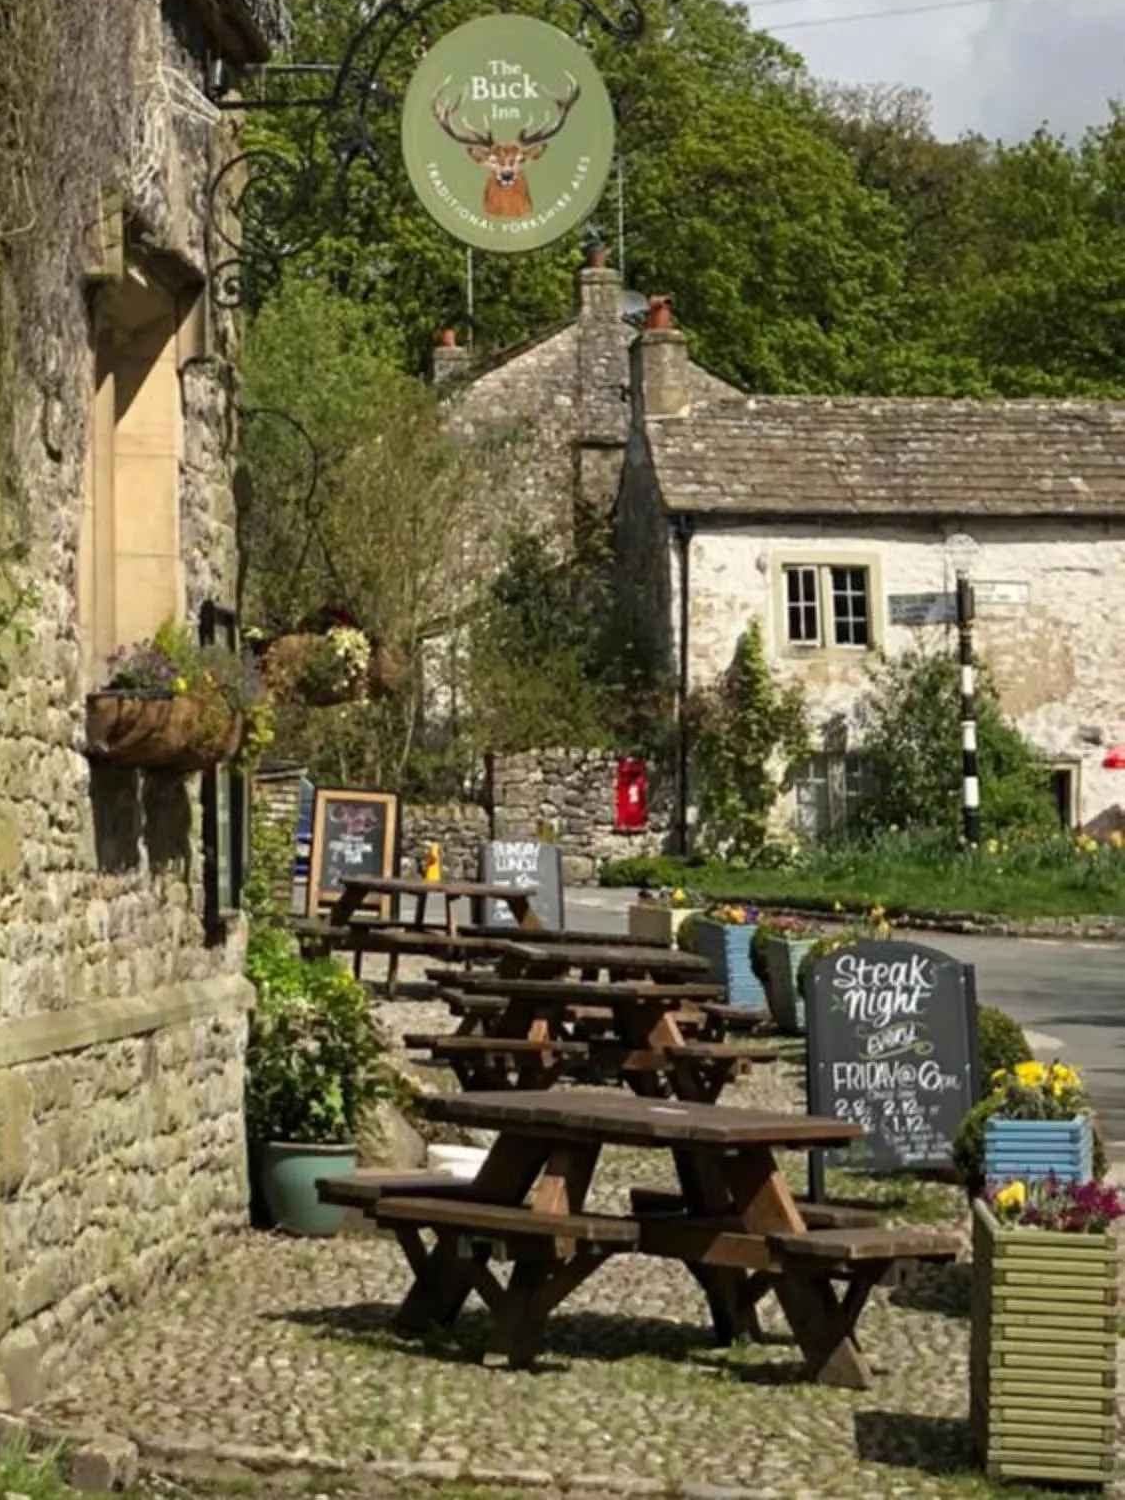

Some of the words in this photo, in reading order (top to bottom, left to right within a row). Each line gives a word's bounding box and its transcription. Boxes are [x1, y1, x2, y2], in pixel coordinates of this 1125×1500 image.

[488, 59, 522, 76] The
[471, 74, 539, 100] Buck
[491, 104, 520, 120] Inn
[427, 162, 496, 232] TRADITIONAL
[501, 191, 572, 234] YORKSHIRE
[571, 156, 591, 190] ALES
[832, 954, 933, 988] Steak
